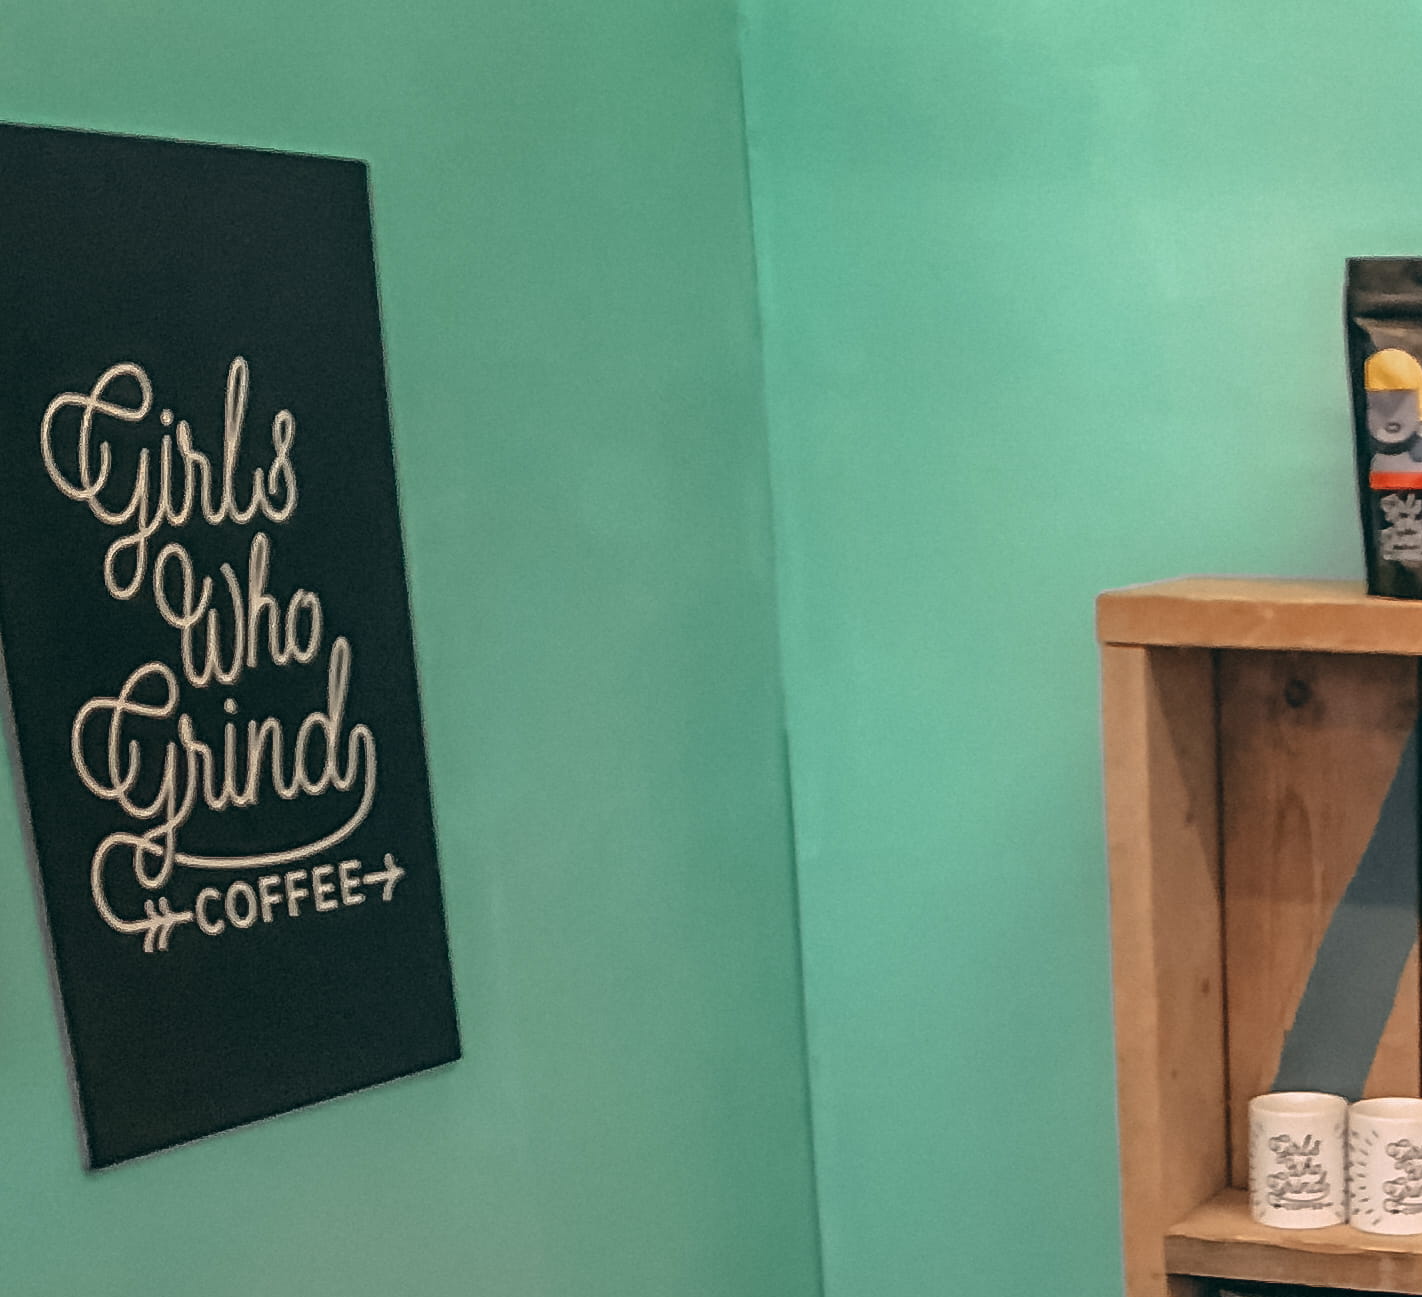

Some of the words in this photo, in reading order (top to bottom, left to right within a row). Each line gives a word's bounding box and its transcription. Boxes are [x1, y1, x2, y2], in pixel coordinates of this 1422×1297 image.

[41, 356, 298, 600] Girls
[154, 531, 322, 687] Who
[71, 636, 377, 888] Grind
[196, 857, 366, 936] COFFEE
